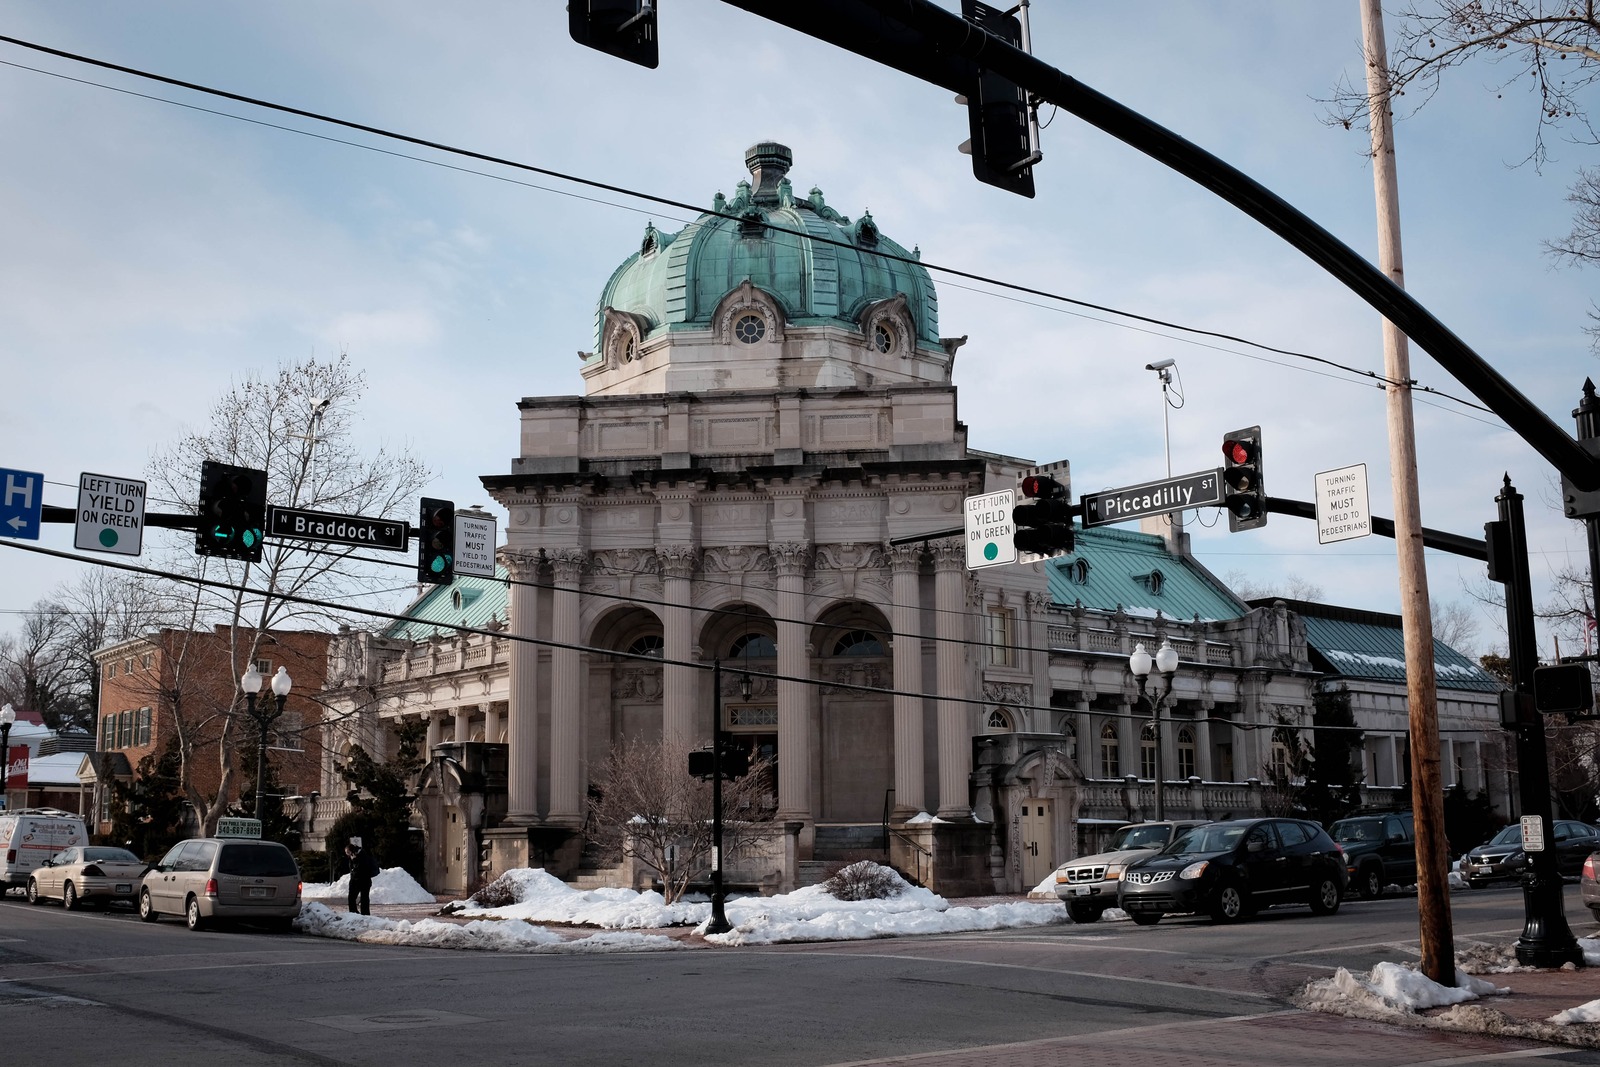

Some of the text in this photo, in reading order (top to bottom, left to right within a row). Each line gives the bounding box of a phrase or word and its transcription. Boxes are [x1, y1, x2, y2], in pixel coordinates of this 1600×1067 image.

[1326, 473, 1356, 486] TURNING
[5, 474, 34, 508] H
[83, 478, 143, 498] LEFT TURN
[1327, 485, 1356, 497] TRAFFIC
[89, 494, 135, 513] YIELD
[968, 494, 1010, 511] LEFT TURN
[1090, 478, 1213, 515] W Piccadilly ST
[1330, 497, 1354, 511] MUST
[82, 510, 138, 529] ON GREEN
[610, 511, 637, 525] THE
[702, 508, 766, 522] HANDLEY
[974, 509, 1005, 525] YIELD
[1328, 510, 1359, 523] YIELD TO
[281, 515, 396, 541] N Braddock ST
[464, 522, 488, 531] TURNING
[970, 525, 1011, 541] ON GREEN
[1321, 521, 1368, 536] PEDESTRIANS
[464, 531, 487, 540] TRAFFIC
[465, 541, 485, 551] MUST
[462, 552, 479, 560] YIELD
[456, 560, 493, 571] PEDESTRIANS
